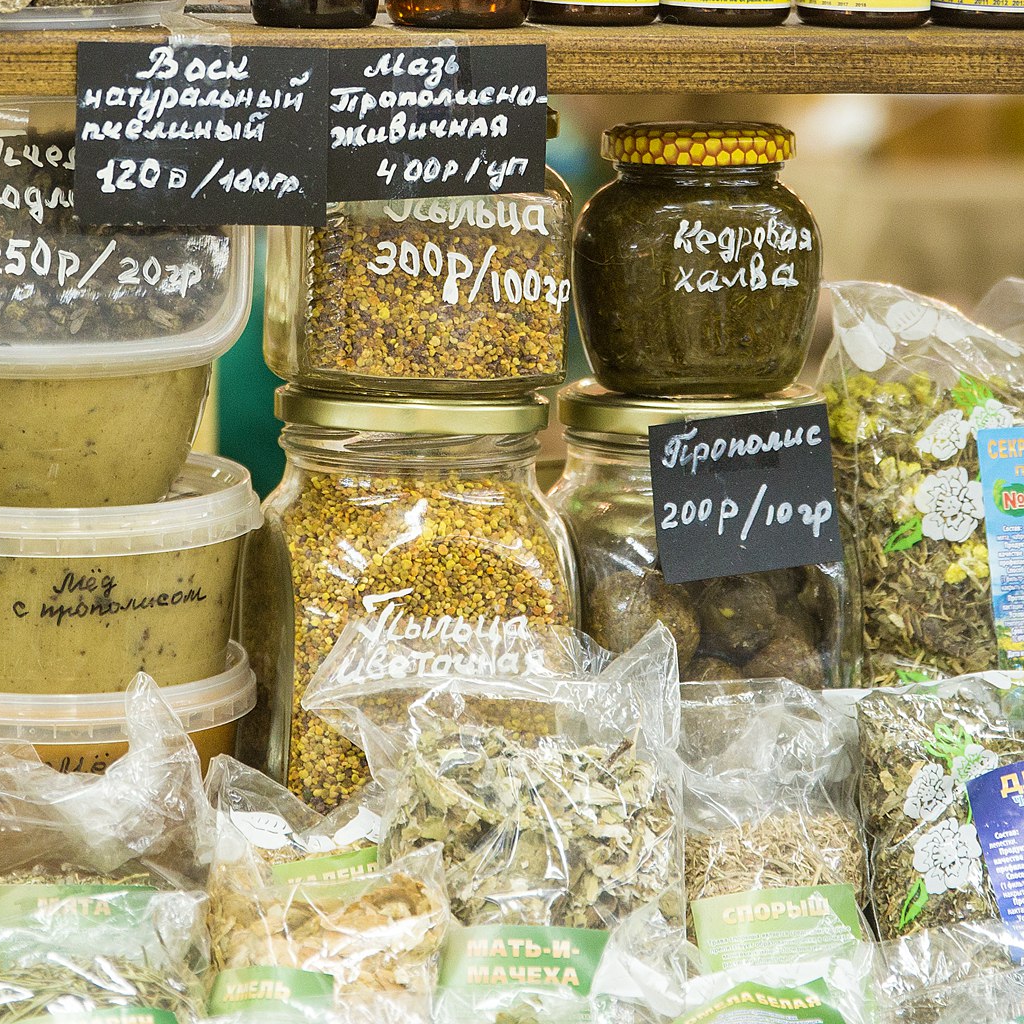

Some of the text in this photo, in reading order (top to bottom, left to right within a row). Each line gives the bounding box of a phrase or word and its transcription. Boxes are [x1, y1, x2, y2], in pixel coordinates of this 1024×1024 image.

[136, 46, 249, 80] Воск
[363, 52, 460, 90] Мазь
[81, 71, 311, 121] натуральный
[329, 85, 547, 120] Прополисно-
[81, 112, 270, 143] пчелиный
[329, 111, 508, 149] живичная
[673, 216, 813, 263] Кедровая
[367, 240, 571, 313] 300р/100гр
[674, 252, 799, 293] халва
[661, 425, 823, 476] Прополис
[12, 587, 207, 626] с прополисом
[356, 587, 530, 648] Пыльца
[43, 752, 110, 774] Мё
[994, 829, 1020, 840] Состав:
[466, 938, 581, 959] МАТЬ-И-
[466, 965, 581, 987] МАЧЕХА
